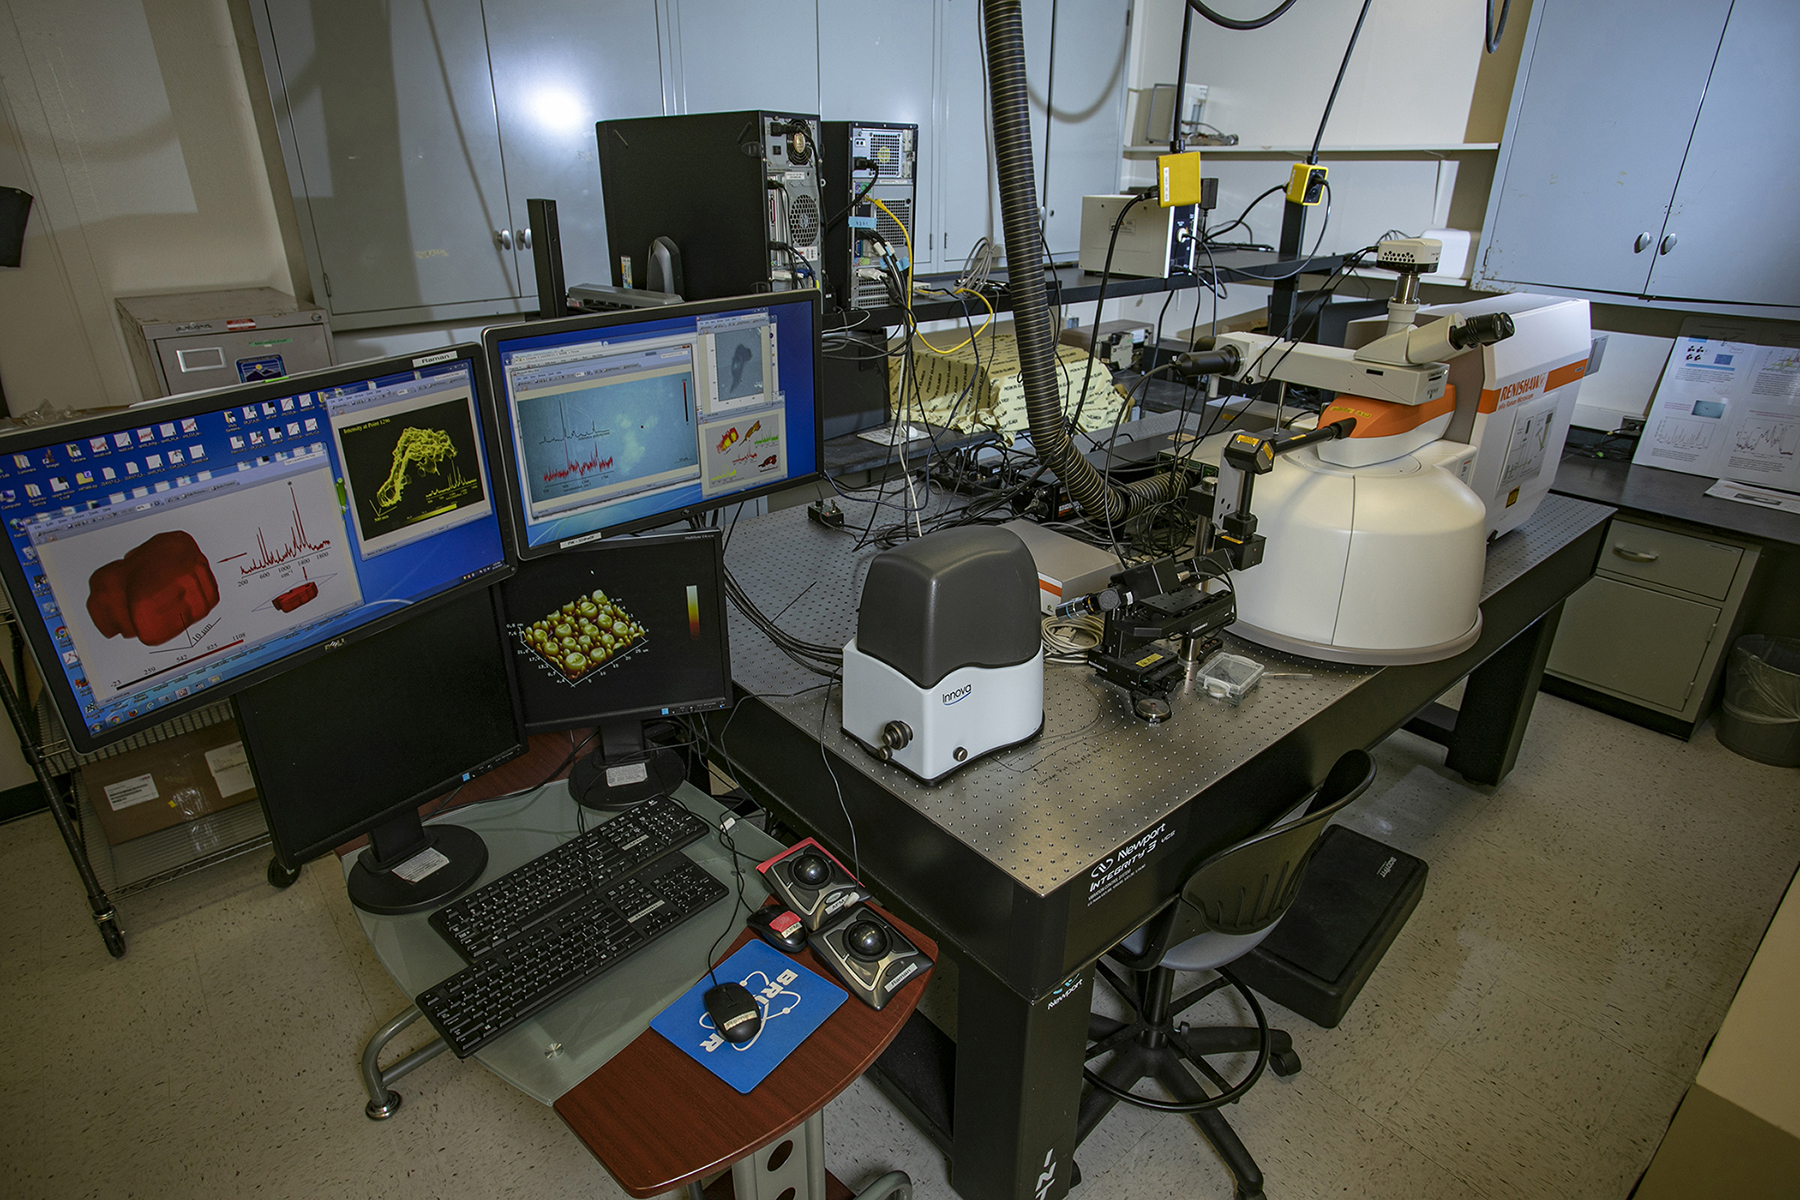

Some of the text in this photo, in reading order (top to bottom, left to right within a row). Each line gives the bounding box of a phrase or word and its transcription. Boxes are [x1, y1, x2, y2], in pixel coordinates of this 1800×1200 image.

[421, 353, 450, 364] Raman
[1500, 375, 1540, 402] RENISHAW
[343, 425, 362, 434] Intensity
[1, 502, 21, 510] Computer
[316, 552, 329, 560] 1800
[298, 558, 311, 566] 1400
[278, 565, 291, 574] 1000
[259, 572, 271, 580] 600
[237, 579, 249, 588] 200
[176, 654, 188, 663] 542
[144, 666, 156, 675] 259
[110, 680, 121, 688] -23
[942, 684, 972, 703] Innova
[1118, 823, 1166, 862] Newport
[1090, 848, 1146, 892] INTEGRITY
[891, 969, 911, 986] Raman
[1048, 978, 1083, 1010] Newport
[700, 969, 798, 1052] BRUR
